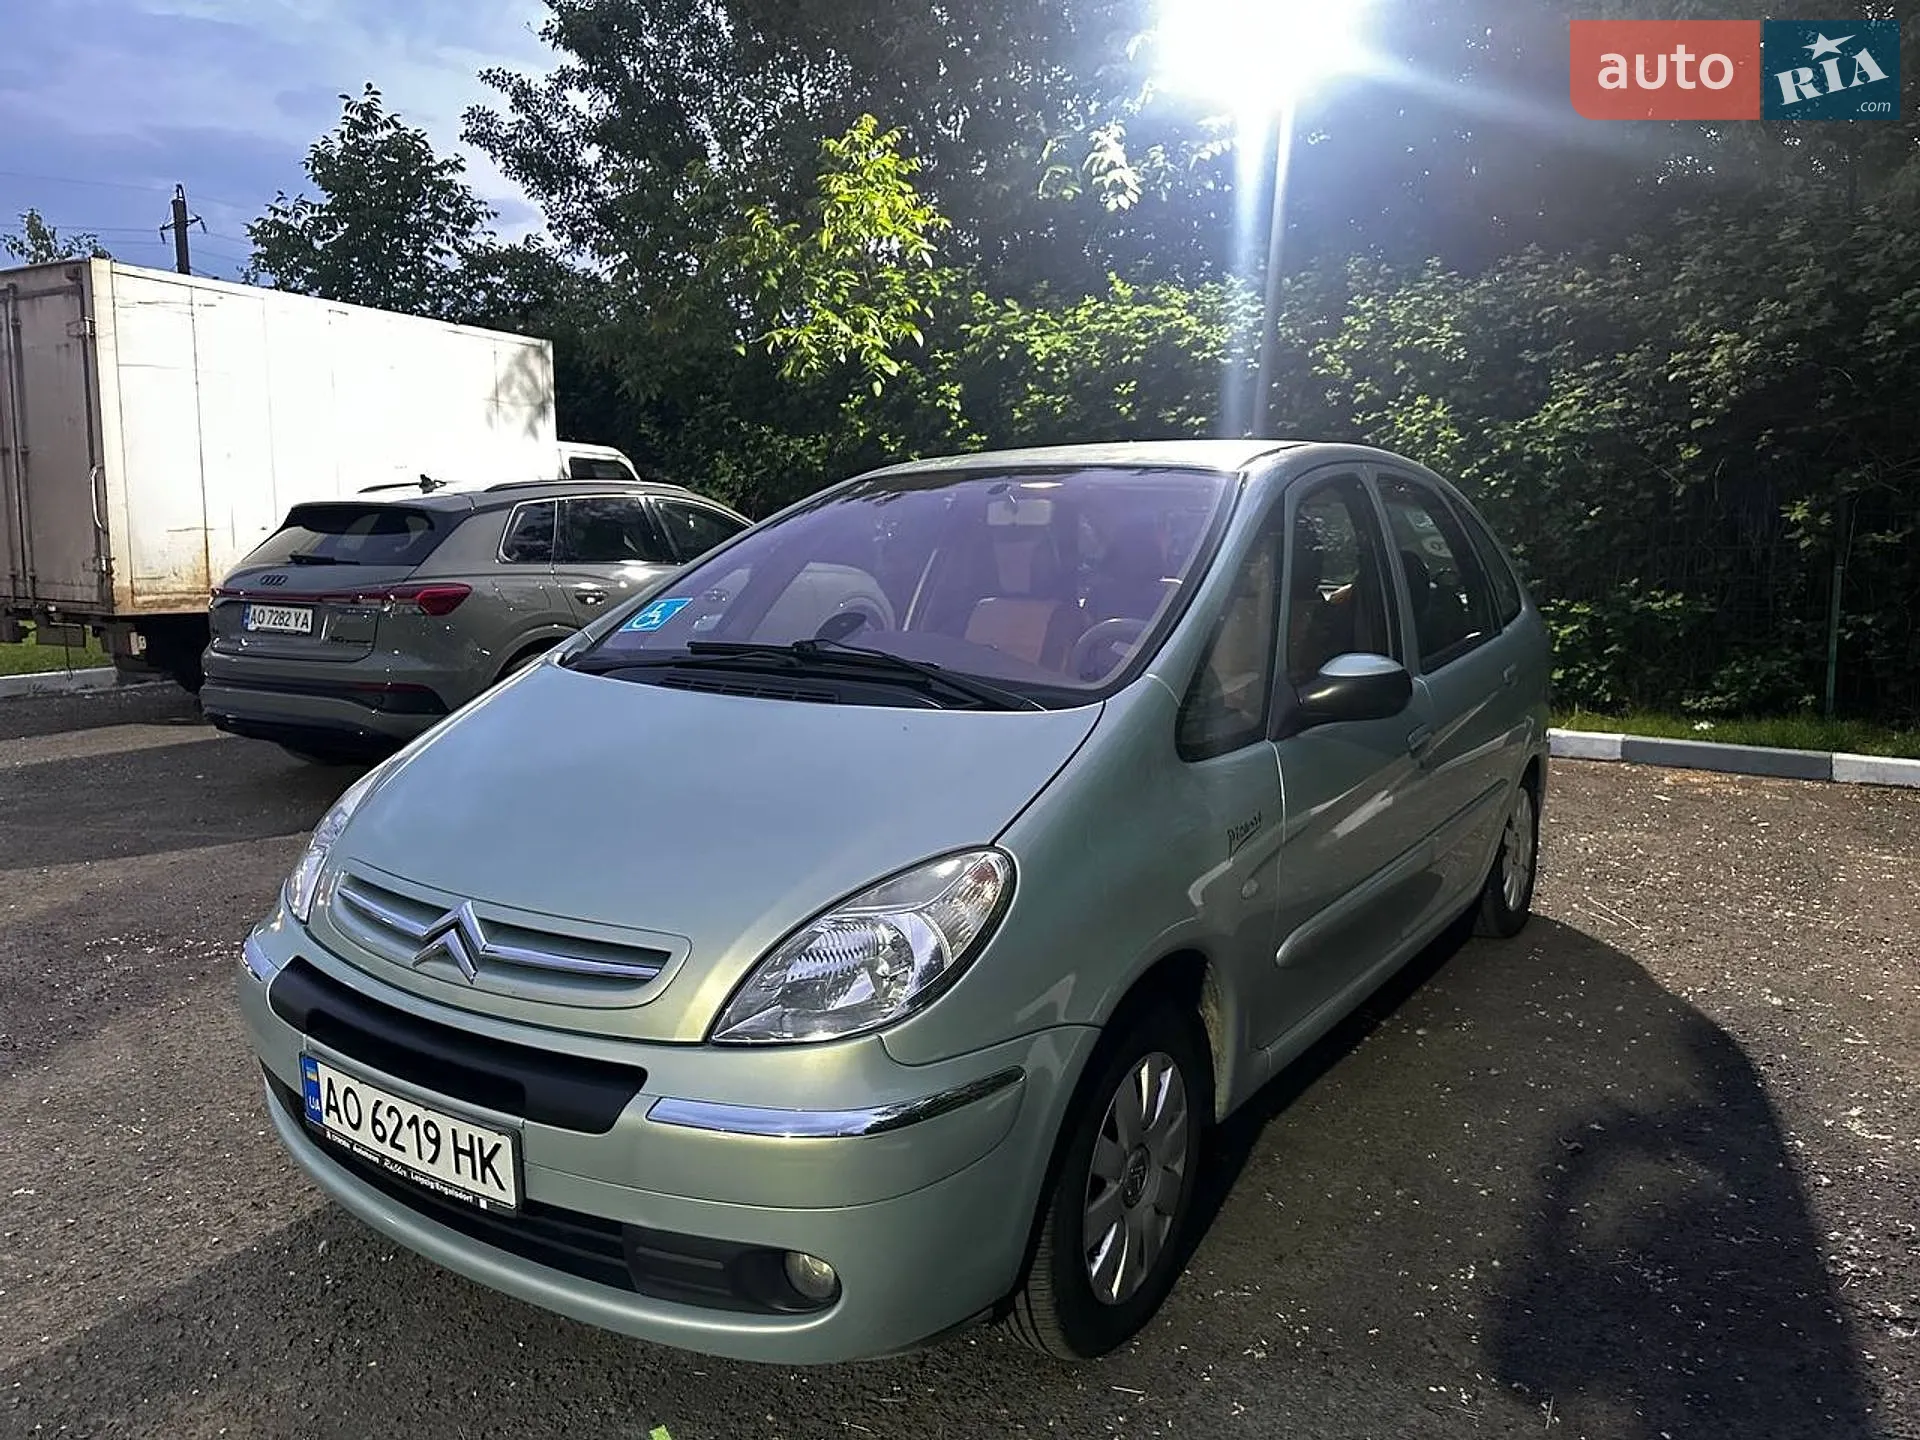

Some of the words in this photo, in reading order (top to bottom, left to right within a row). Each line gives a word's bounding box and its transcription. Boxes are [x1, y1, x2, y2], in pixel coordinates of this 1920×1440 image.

[250, 608, 265, 625] AO
[267, 608, 291, 627] 7282
[294, 611, 309, 629] YA
[309, 1095, 321, 1112] UA
[325, 1077, 362, 1131] AO
[371, 1099, 441, 1164] 6219
[451, 1128, 506, 1191] HK
